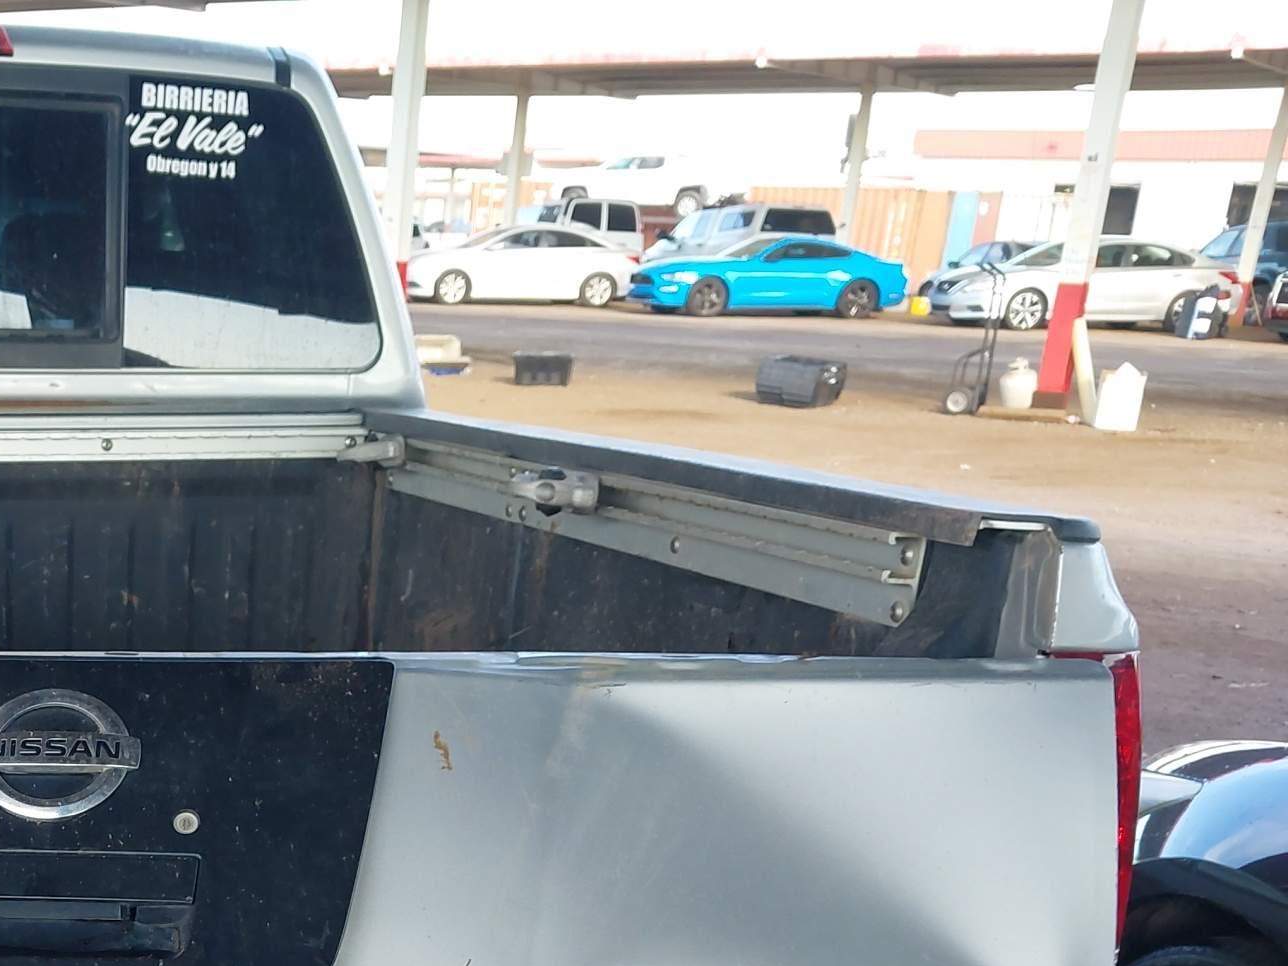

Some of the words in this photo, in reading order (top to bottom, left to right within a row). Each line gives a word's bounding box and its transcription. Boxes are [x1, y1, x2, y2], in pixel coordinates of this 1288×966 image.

[141, 82, 250, 117] BIRRIERIA
[146, 153, 207, 177] Obregon
[208, 160, 219, 179] y
[220, 160, 236, 179] 14
